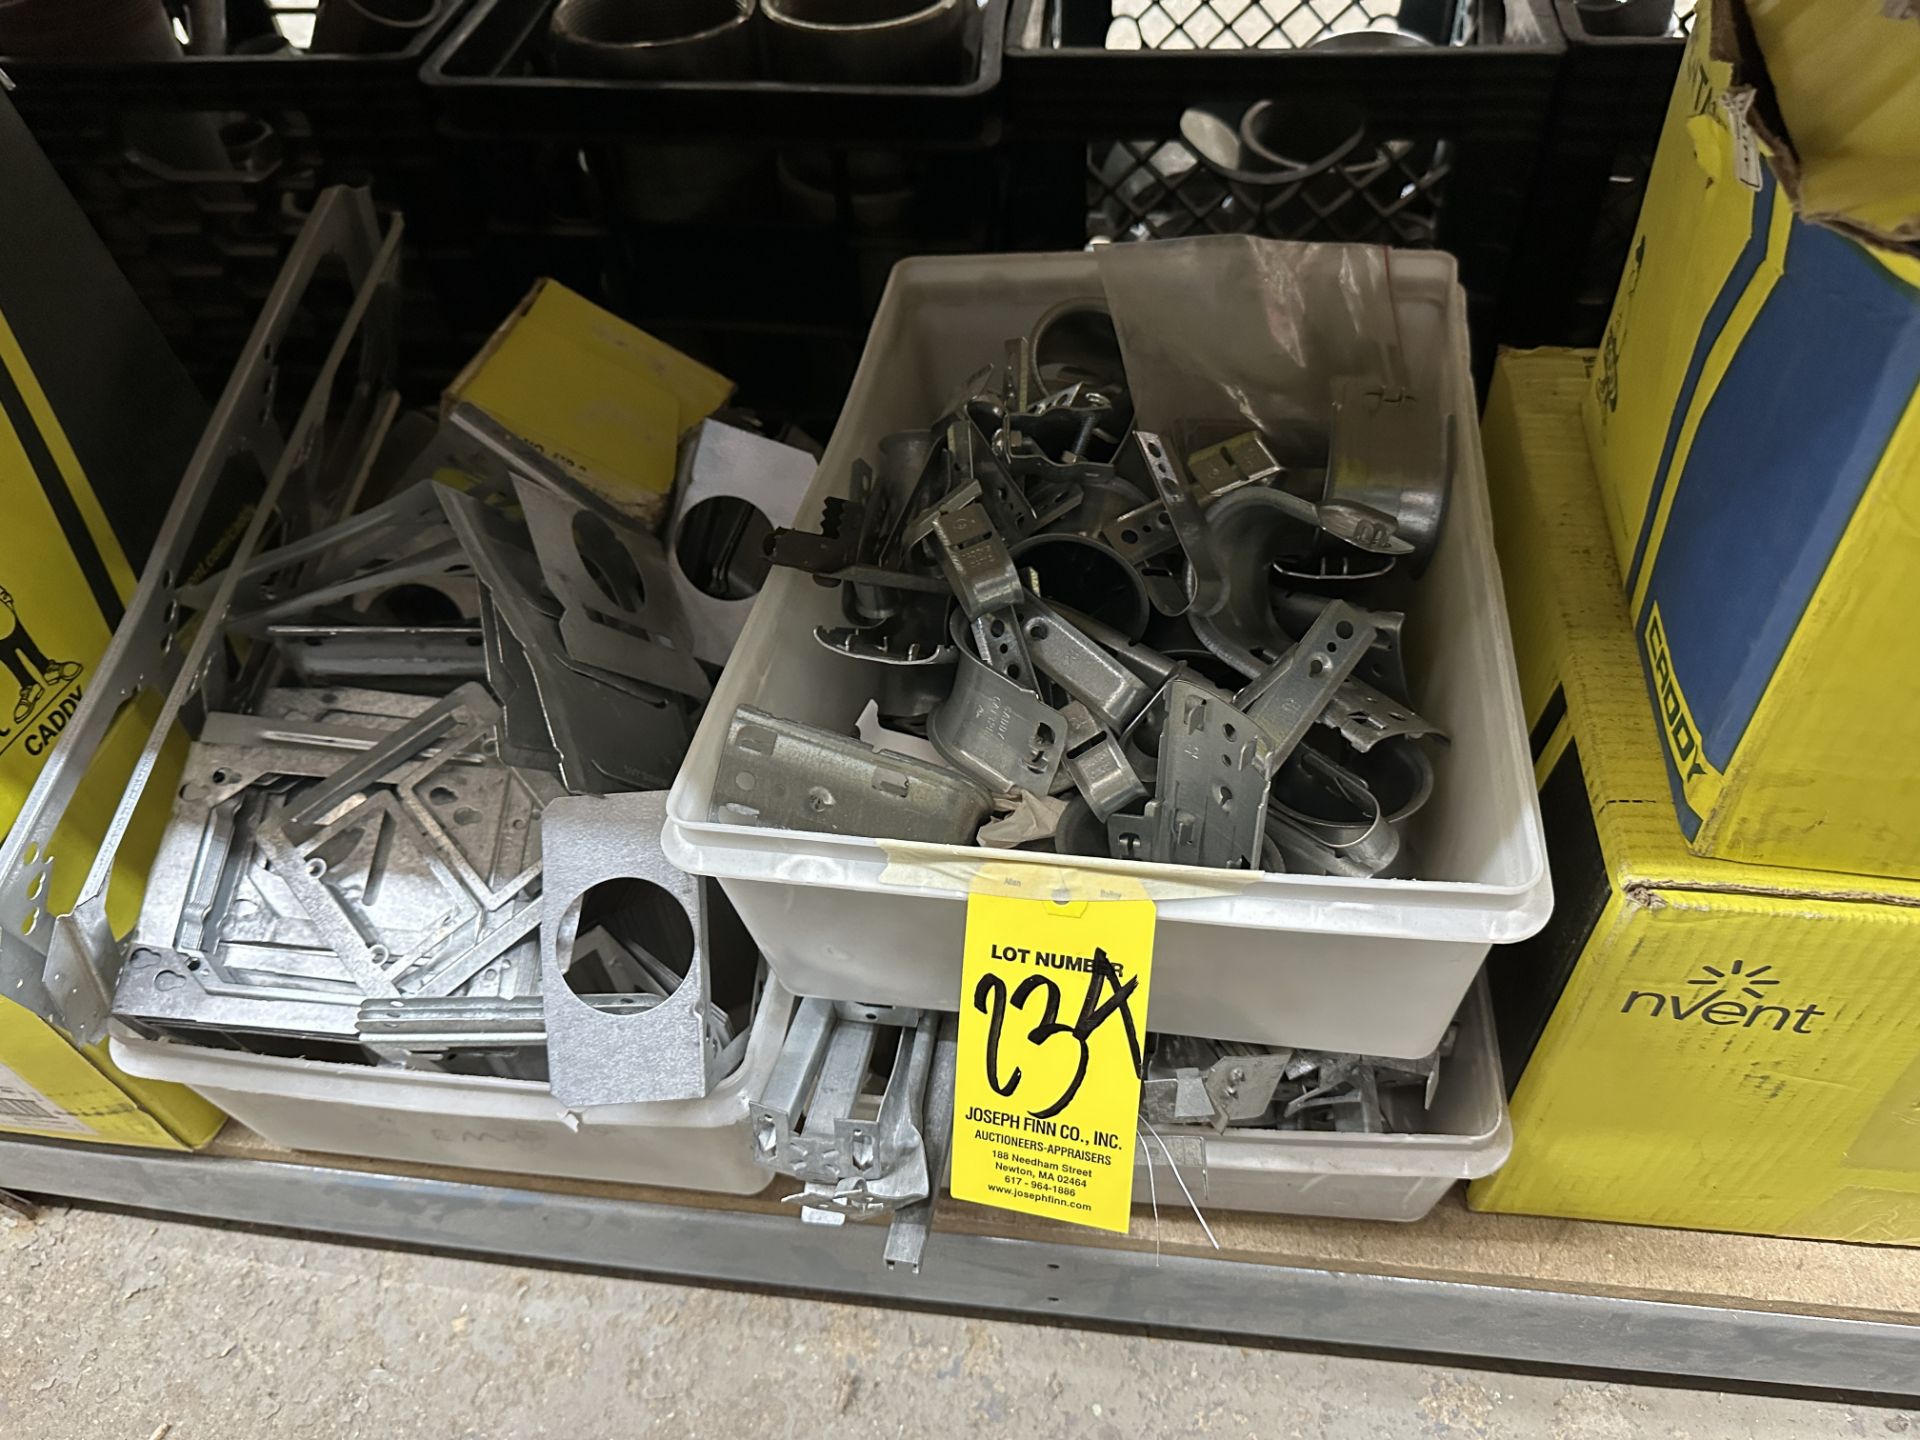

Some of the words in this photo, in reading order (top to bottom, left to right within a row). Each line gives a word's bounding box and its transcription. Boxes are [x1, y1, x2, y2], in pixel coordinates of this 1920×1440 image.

[1650, 616, 1707, 783] CADDY
[991, 944, 1030, 964] LOT
[1035, 951, 1124, 978] NUMBR
[974, 947, 1142, 1120] 23A
[965, 1106, 1020, 1130] JOSEPH
[1023, 1116, 1057, 1137] FINN
[1060, 1124, 1089, 1146] CO.,
[1093, 1130, 1122, 1150] INC.
[974, 1129, 1112, 1166] AUCTIONEERS-APPRAISERS
[992, 1150, 1009, 1160] 188
[1011, 1153, 1059, 1171] Needham
[1061, 1163, 1092, 1178] Street
[995, 1162, 1036, 1179] Newton,
[1038, 1171, 1055, 1181] MA
[1057, 1175, 1087, 1188] 02464
[1004, 1175, 1022, 1186] 617
[1030, 1181, 1076, 1197] 964-1886
[987, 1183, 1092, 1211] www.josephfinn.com
